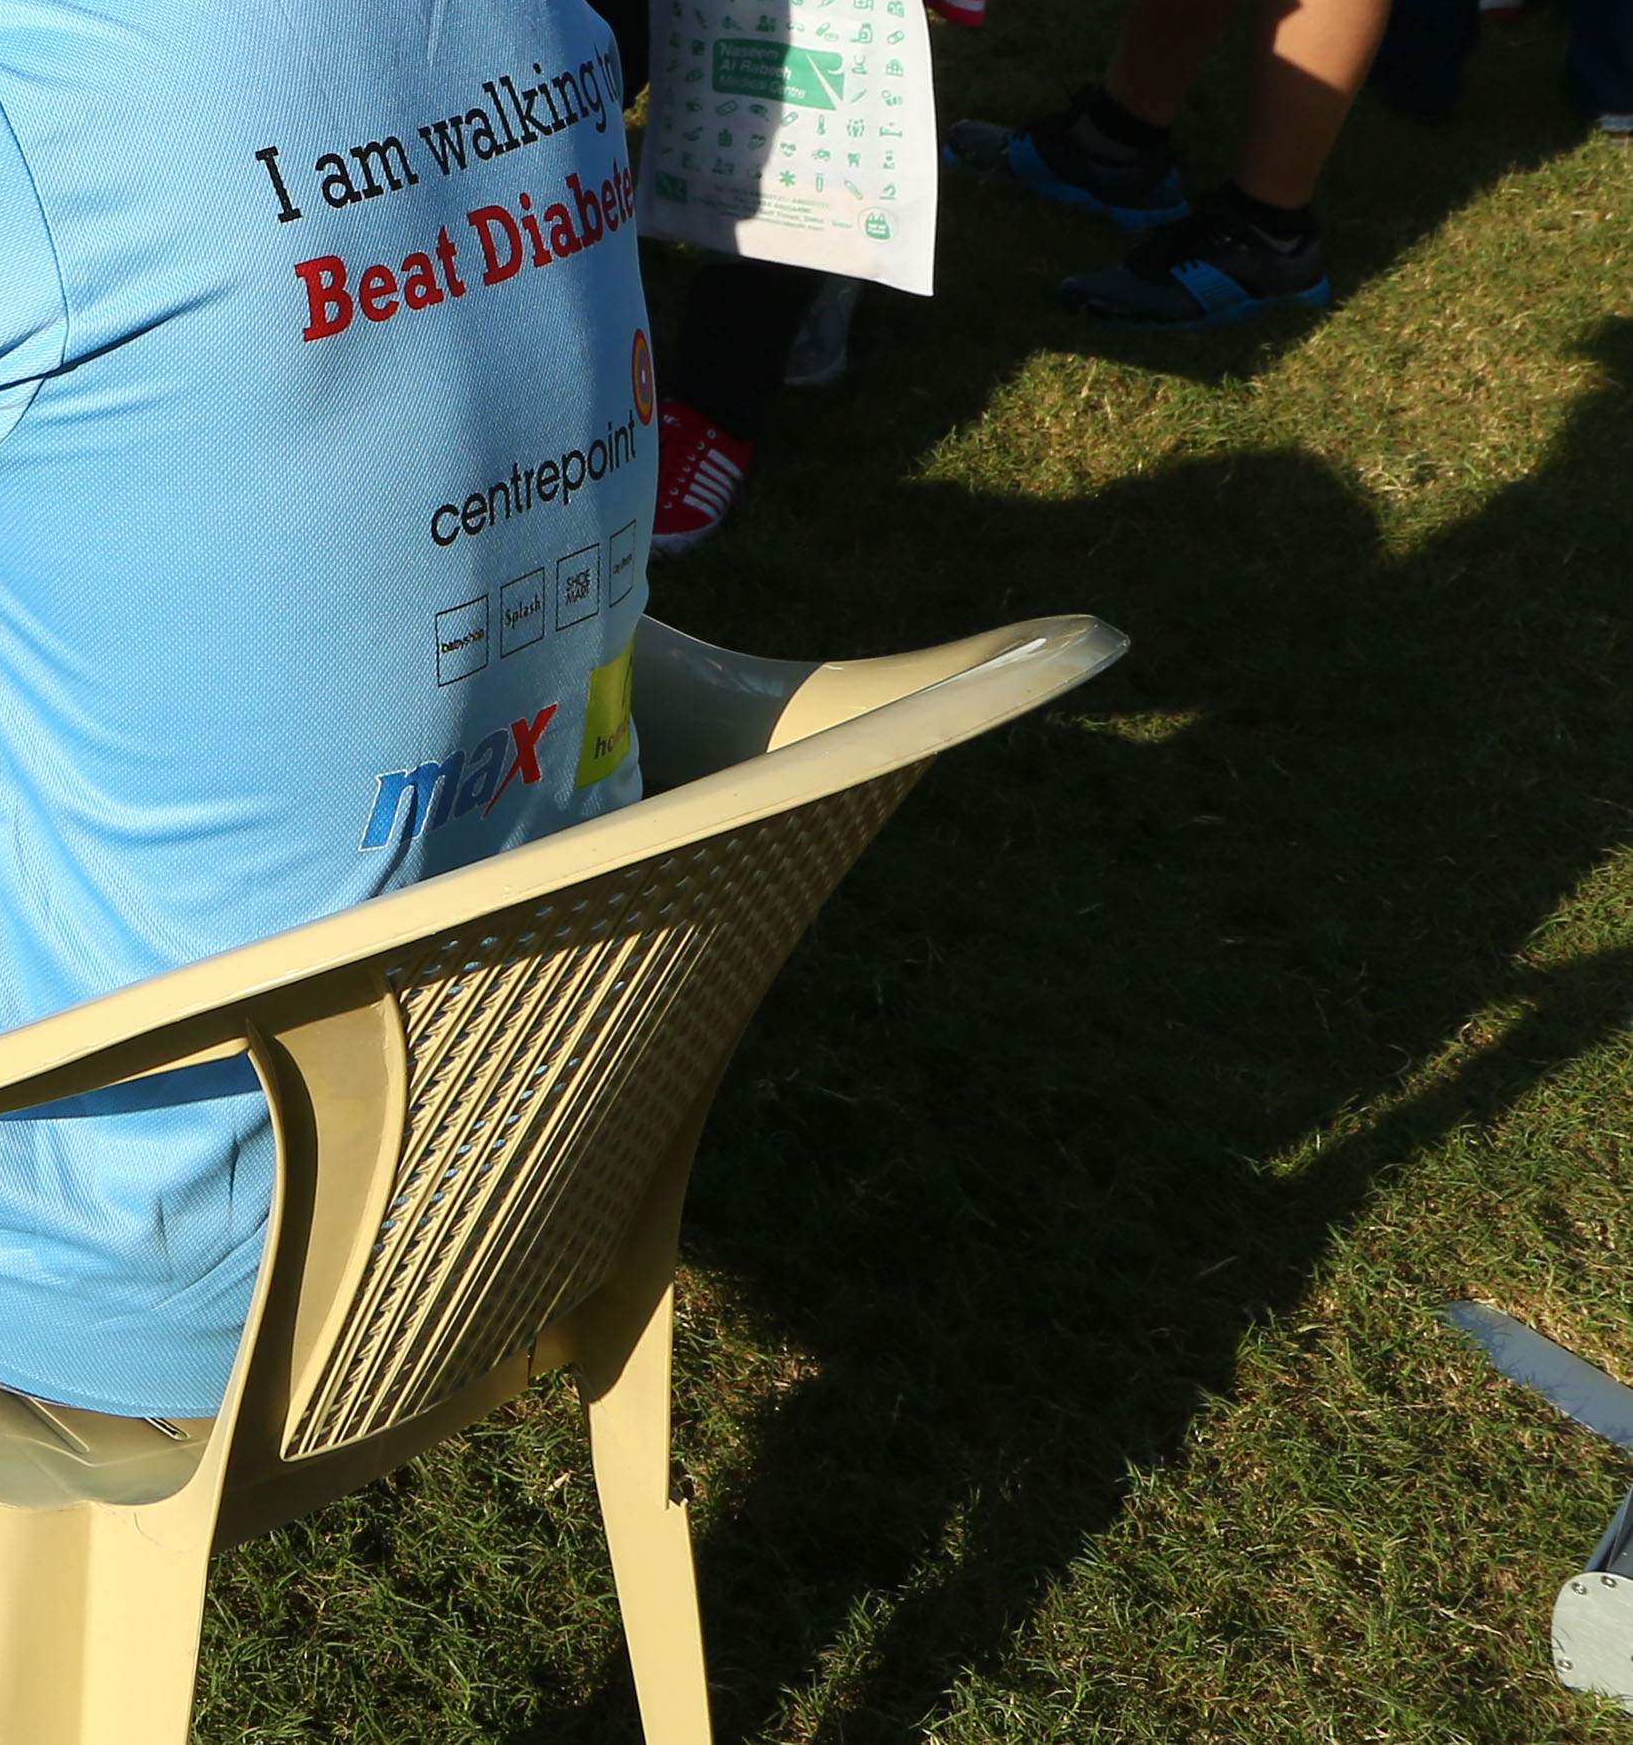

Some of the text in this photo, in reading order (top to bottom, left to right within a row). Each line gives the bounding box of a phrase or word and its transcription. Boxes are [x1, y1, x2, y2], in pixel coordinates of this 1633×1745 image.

[256, 145, 304, 224] I
[314, 133, 419, 210] am
[417, 60, 607, 179] walking
[294, 224, 466, 343] Beat
[466, 157, 635, 286] Diabete
[430, 407, 638, 548] centrepoint
[504, 594, 543, 630] Splash
[565, 567, 592, 590] SHOE
[358, 701, 561, 852] max
